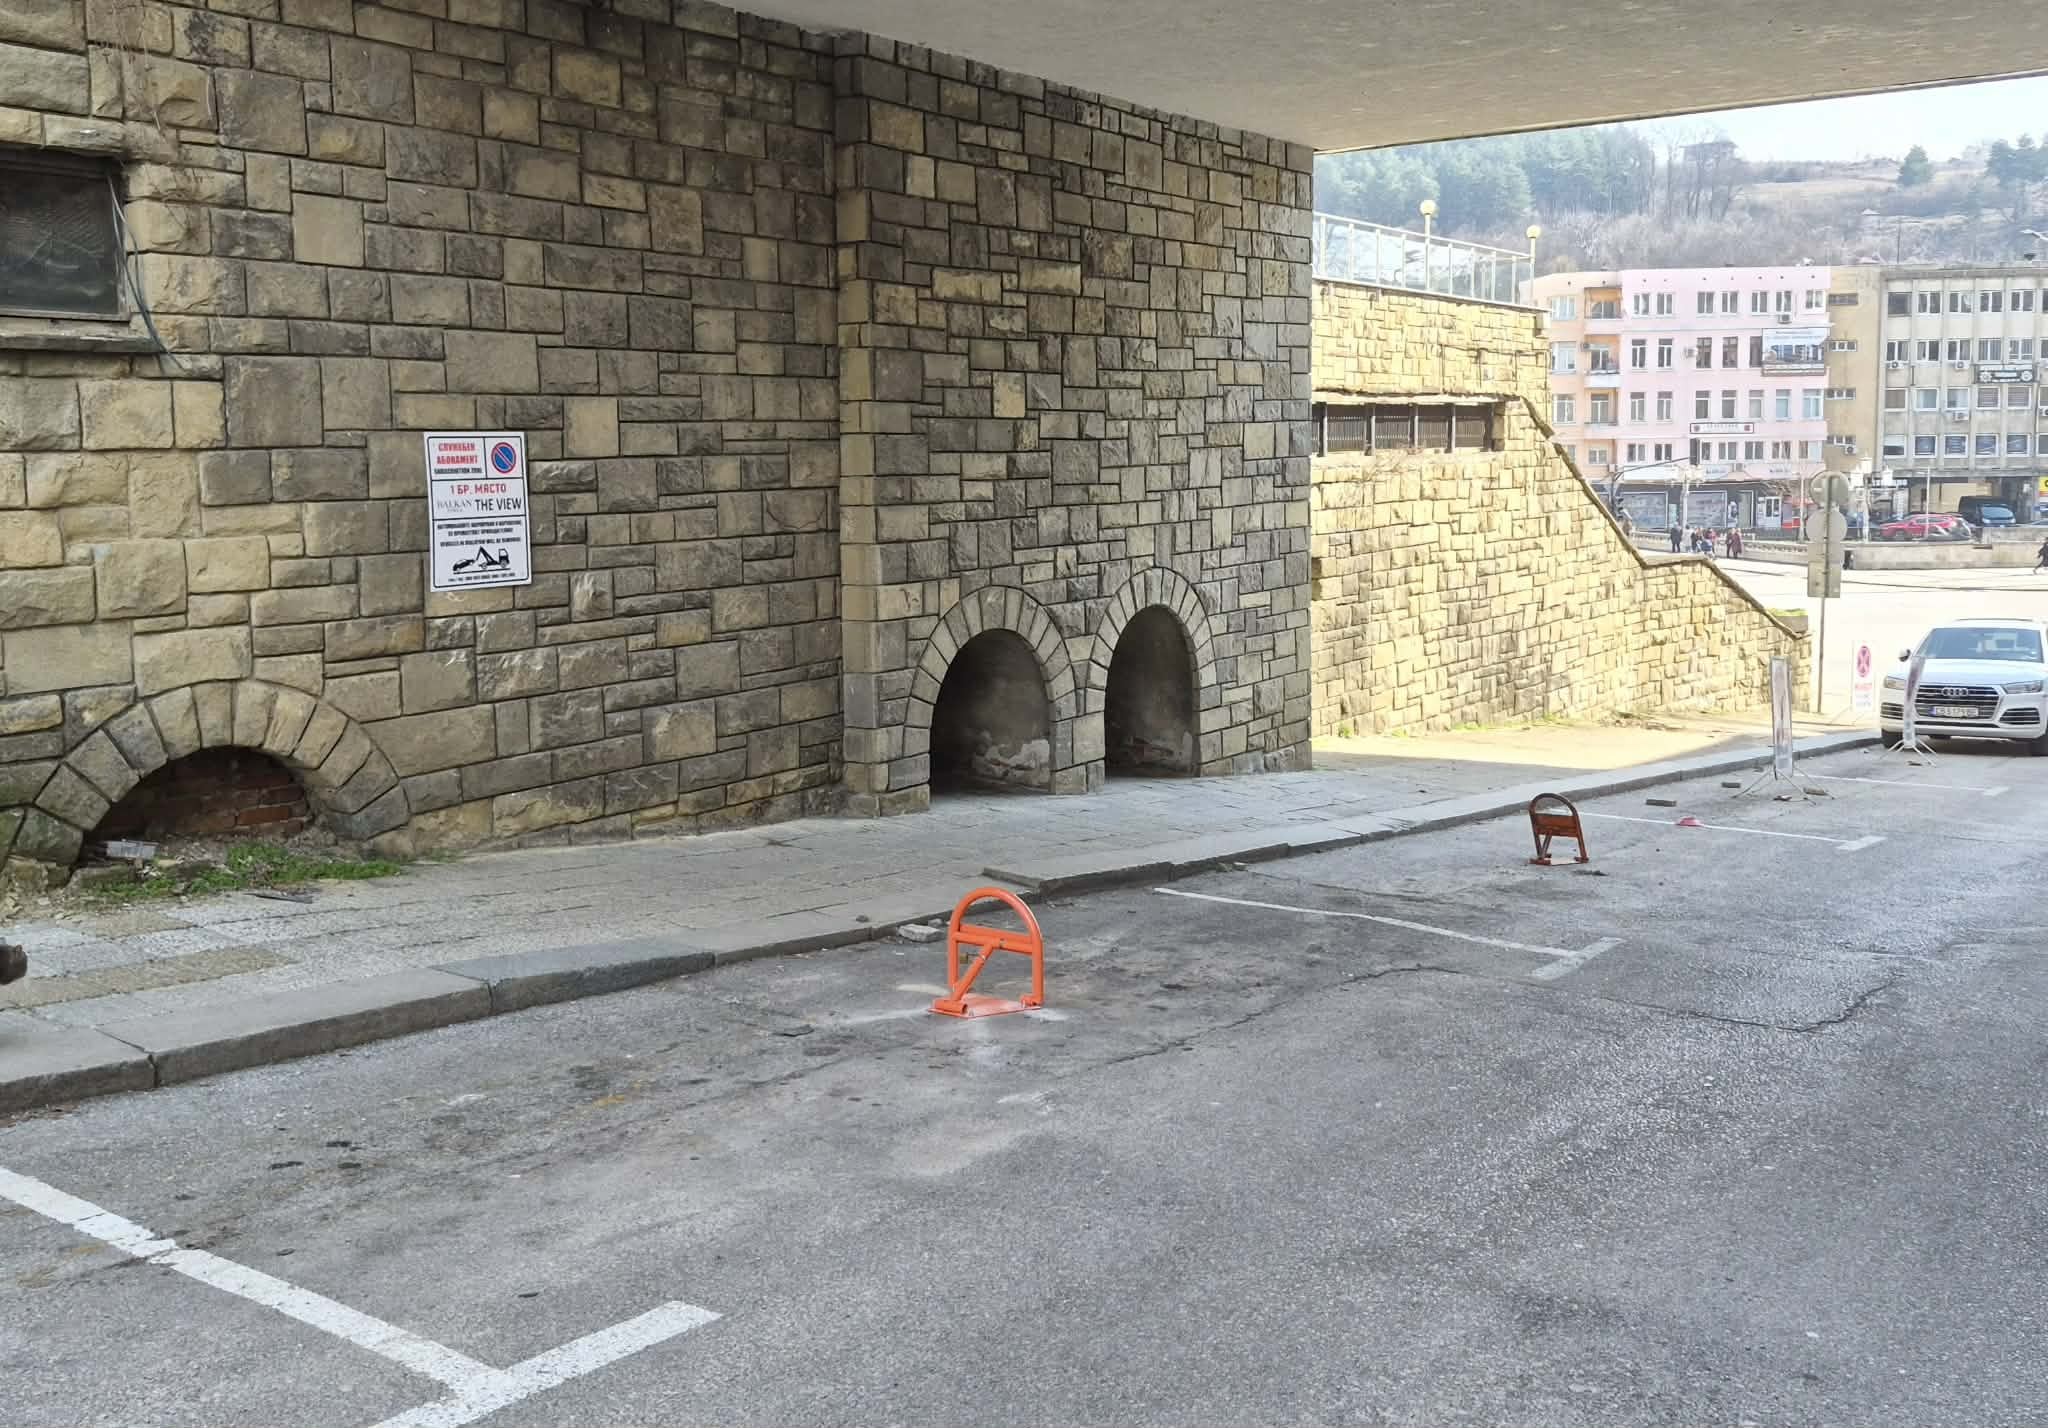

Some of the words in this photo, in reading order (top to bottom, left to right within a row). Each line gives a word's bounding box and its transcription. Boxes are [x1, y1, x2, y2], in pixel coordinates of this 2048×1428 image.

[436, 455, 478, 464] АБОНАМЕНТ
[450, 484, 454, 494] 1
[474, 483, 507, 494] МЯСТО
[475, 498, 494, 511] THE
[495, 498, 522, 510] VIEW
